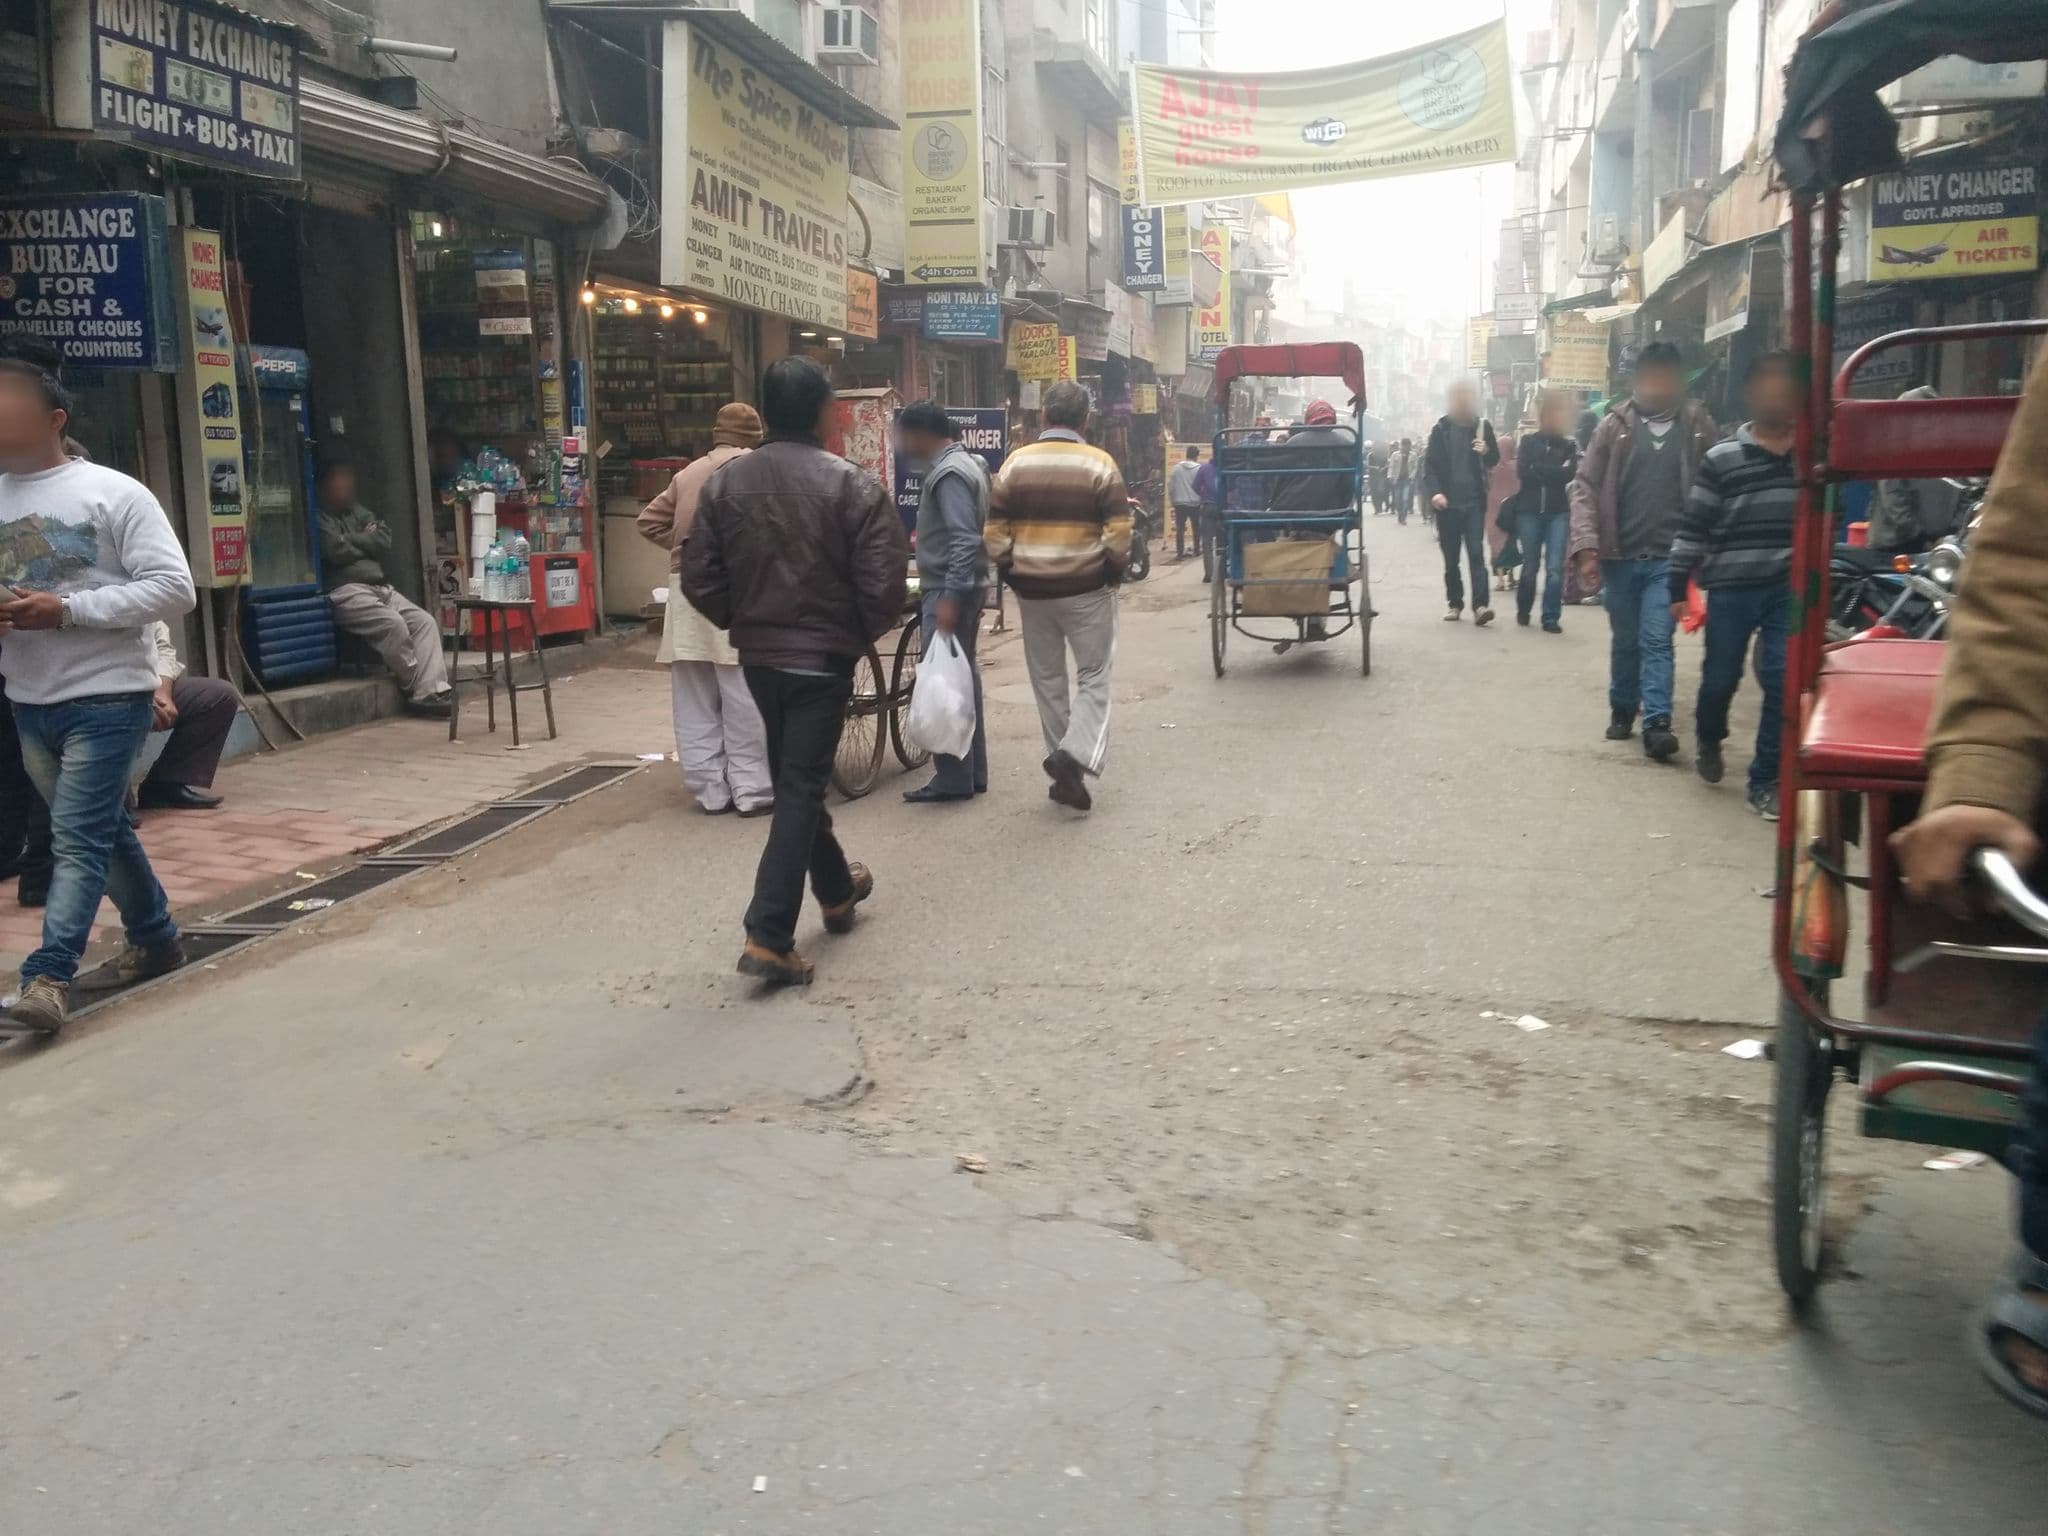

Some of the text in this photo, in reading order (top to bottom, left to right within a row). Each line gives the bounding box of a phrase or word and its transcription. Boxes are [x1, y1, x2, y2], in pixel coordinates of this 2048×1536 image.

[97, 0, 292, 87] MONEY EXCHANGE
[693, 31, 734, 100] The
[739, 67, 791, 132] Spice
[1160, 74, 1262, 119] AJAY
[100, 87, 294, 166] FLIGHT BUS TAXI
[1177, 118, 1253, 147] guest
[1156, 137, 1501, 192] ROOFTOP RESTAURANT ORGANIC GERMAN BAKERY
[1174, 144, 1261, 167] house
[915, 185, 967, 194] RESTAURANT
[1878, 167, 2035, 204] MONEY CHANGER
[926, 196, 957, 204] BAKERY
[691, 168, 753, 229] AMIT
[759, 198, 844, 268] TRAVELS
[912, 206, 972, 215] ORGANIC SHOP
[1904, 202, 2005, 221] GOVT. APPROVED
[692, 217, 718, 239] MONEY
[1977, 228, 2010, 243] AIR
[1131, 206, 1153, 273] MONEY
[11, 244, 118, 273] BUREAU
[192, 242, 216, 265] MONEY
[687, 237, 722, 262] CHANGER
[728, 232, 750, 250] TRAIN
[782, 252, 795, 270] BUS
[796, 258, 819, 278] TICKETS
[1953, 245, 2034, 264] TICKETS
[190, 268, 222, 292] CHANGER
[729, 256, 743, 271] AIR
[774, 271, 789, 286] TAXI
[790, 277, 818, 297] SERVICES
[921, 267, 973, 278] 24h Open
[1126, 274, 1162, 286] CHANGER
[39, 277, 96, 295] FOR
[723, 274, 768, 306] MONEY
[770, 291, 822, 323] CHANGER
[927, 291, 950, 304] RONI
[15, 298, 123, 317] CASH &
[79, 320, 143, 338] CHEQUES
[1018, 324, 1053, 342] LOOKS
[64, 341, 143, 358] COUNTRIES
[262, 358, 297, 374] PEPSI
[206, 428, 236, 439] BUS TICKETS
[961, 428, 1001, 450] ANGER
[905, 479, 920, 490] ALL
[212, 504, 242, 513] CAR RENTAL
[215, 529, 243, 542] AIR PORT
[222, 544, 237, 556] TAXI
